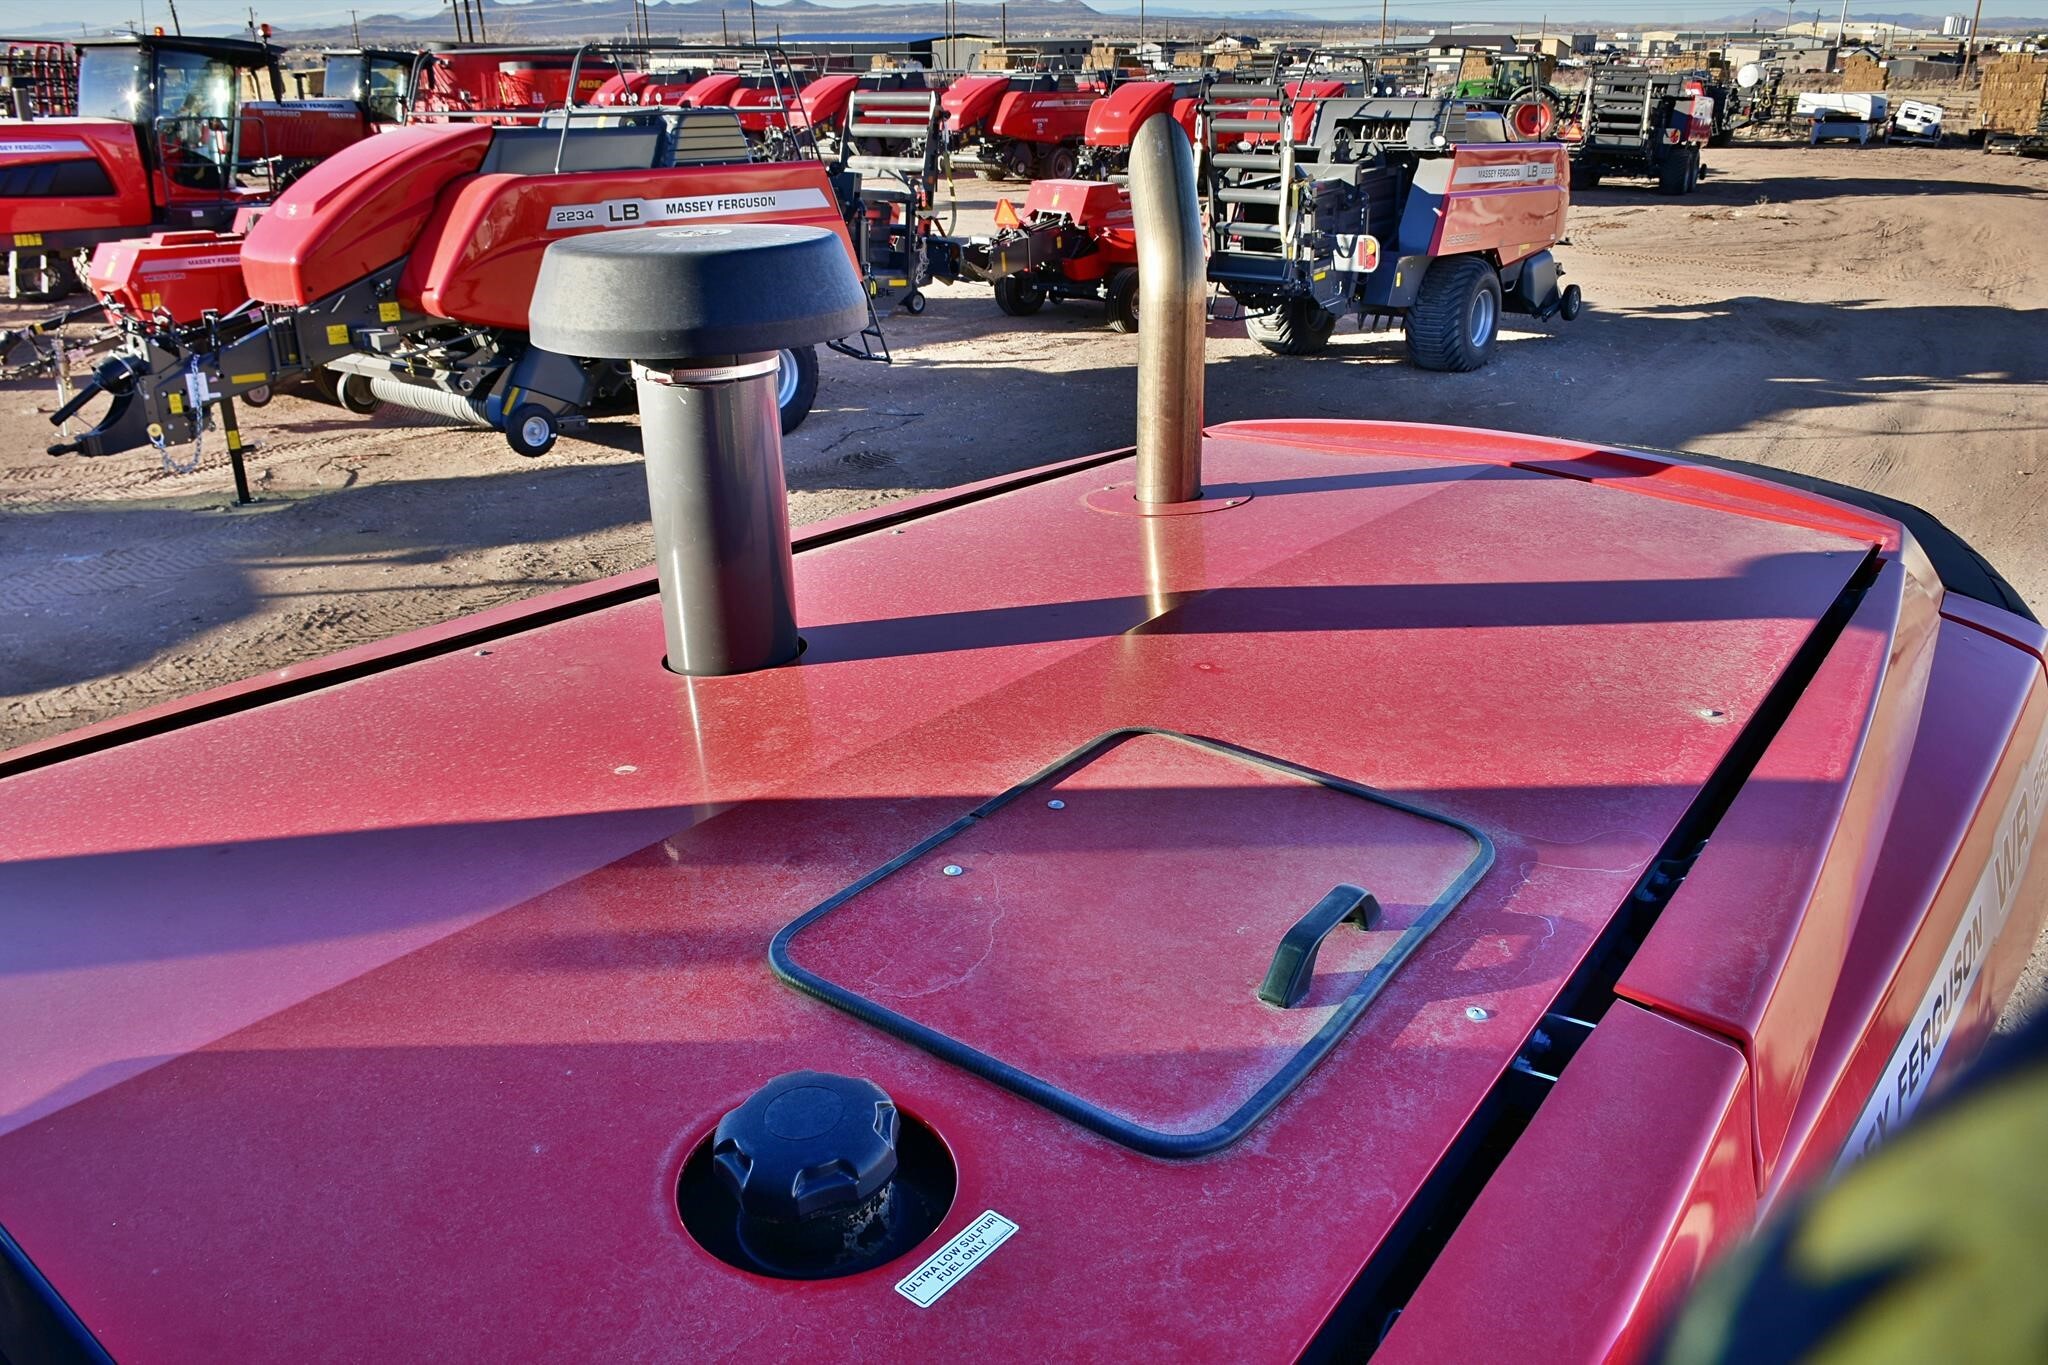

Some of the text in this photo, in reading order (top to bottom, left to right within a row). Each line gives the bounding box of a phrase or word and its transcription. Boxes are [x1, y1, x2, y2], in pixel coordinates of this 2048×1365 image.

[1478, 168, 1497, 178] MASSEY
[1498, 167, 1521, 178] FERGUSON
[1527, 165, 1538, 178] LB
[556, 196, 777, 222] 2234 LB MASSEY FERGUSON
[1897, 905, 1984, 1121] FERGUSON
[1994, 790, 2029, 910] WR
[905, 1265, 940, 1293] ULTRA
[937, 1246, 961, 1267] LOW
[960, 1217, 998, 1248] SULFUR
[936, 1239, 988, 1282] FUEL ONLY
